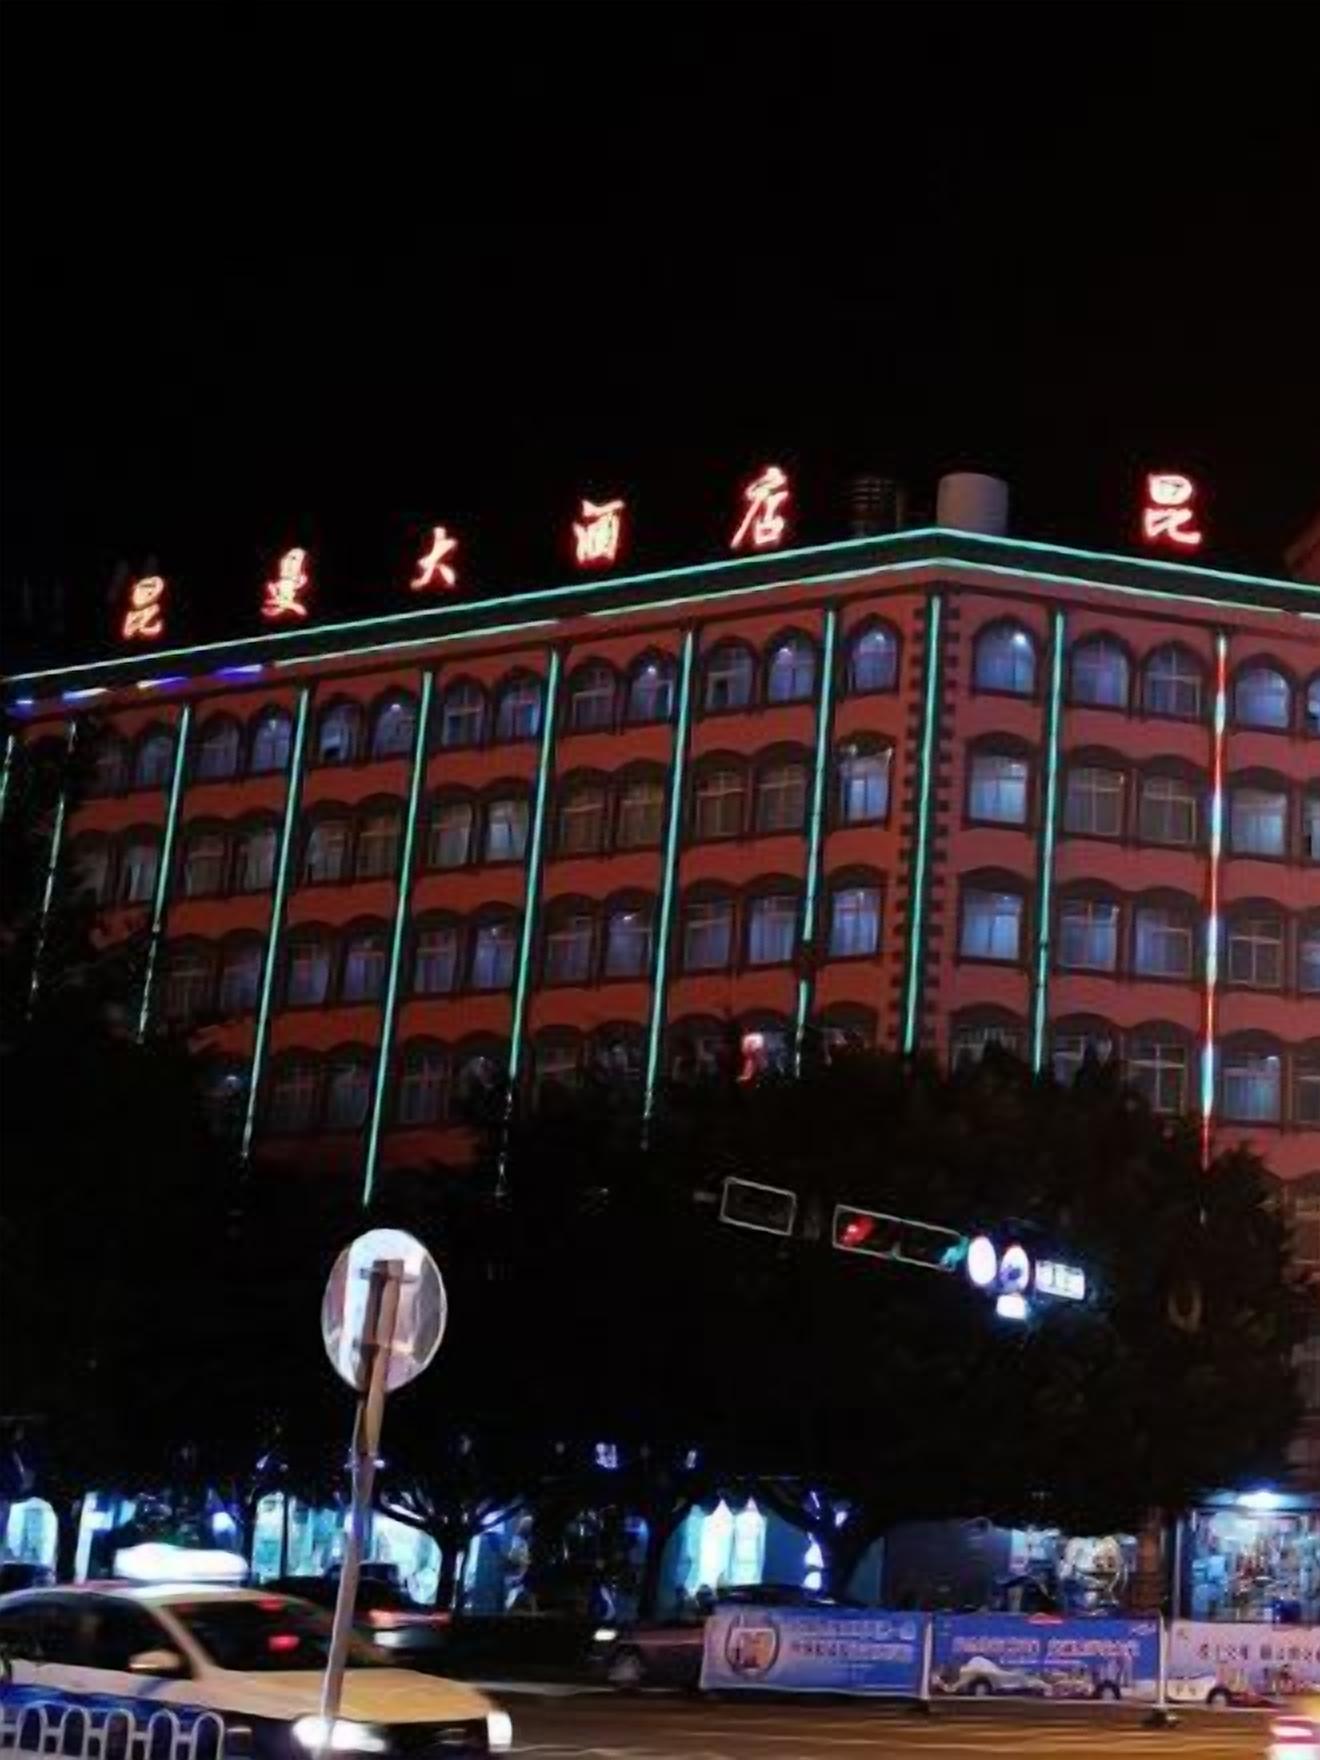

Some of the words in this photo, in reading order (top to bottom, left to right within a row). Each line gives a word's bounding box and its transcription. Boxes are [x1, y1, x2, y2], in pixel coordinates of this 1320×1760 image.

[124, 467, 788, 637] 昆曼大酒店
